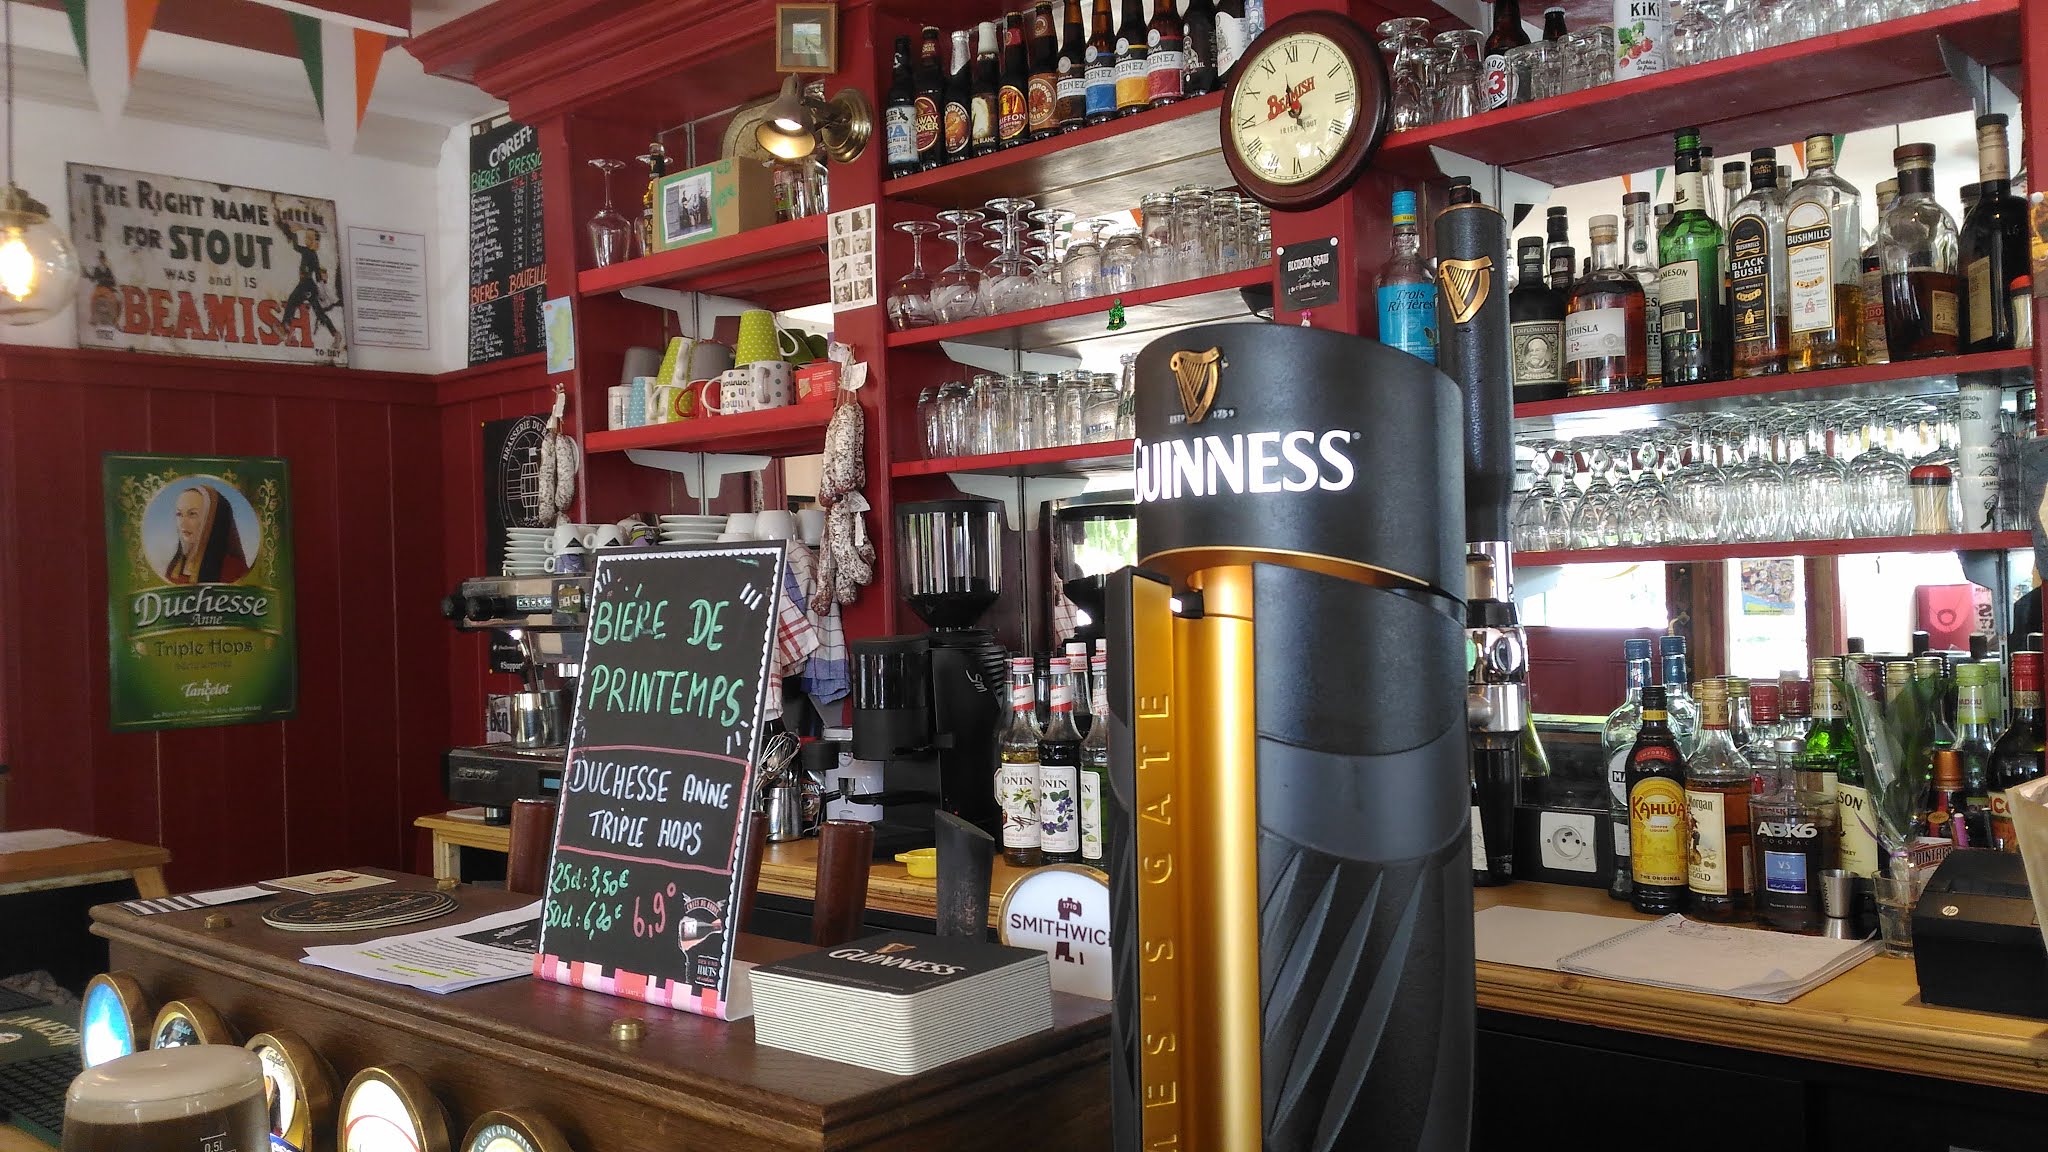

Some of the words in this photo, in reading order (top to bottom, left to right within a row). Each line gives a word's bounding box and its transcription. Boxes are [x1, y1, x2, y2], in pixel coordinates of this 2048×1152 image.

[1280, 124, 1298, 135] IRISH
[136, 180, 204, 217] RIGHT
[211, 198, 270, 227] NAME
[1787, 228, 1830, 245] BUSHMILLS
[123, 225, 162, 249] FOR
[169, 224, 273, 270] STOUT
[1732, 257, 1765, 271] BLACK
[1734, 267, 1763, 279] BUSH
[163, 267, 197, 283] WAS
[208, 275, 231, 287] and
[243, 277, 257, 289] IS
[1396, 289, 1425, 300] Trois
[121, 285, 315, 349] BEAMISH
[532, 420, 543, 432] DU
[1134, 430, 1355, 505] GUINNESS
[133, 586, 268, 627] Duchesse
[190, 613, 223, 626] Anne
[687, 599, 730, 651] DE
[155, 640, 205, 658] Triple
[209, 640, 254, 655] Hops
[588, 664, 745, 727] PRINTEMPS
[569, 758, 672, 802] DUCHESSE
[682, 773, 733, 810] ANNE
[1002, 776, 1033, 786] ONIN
[1041, 779, 1068, 789] ONIN
[1139, 694, 1174, 885] GATE
[1632, 793, 1688, 822] KAHLÚA
[589, 808, 649, 848] TRIPLE
[657, 818, 703, 856] HOPS
[1756, 821, 1818, 838] ABK6
[1777, 860, 1791, 869] VS
[1652, 874, 1681, 882] ORIGINAL
[1062, 902, 1078, 911] 1710
[1943, 905, 1958, 917] hp
[1010, 913, 1111, 946] SMITHWIC
[828, 948, 967, 977] GUINNESS
